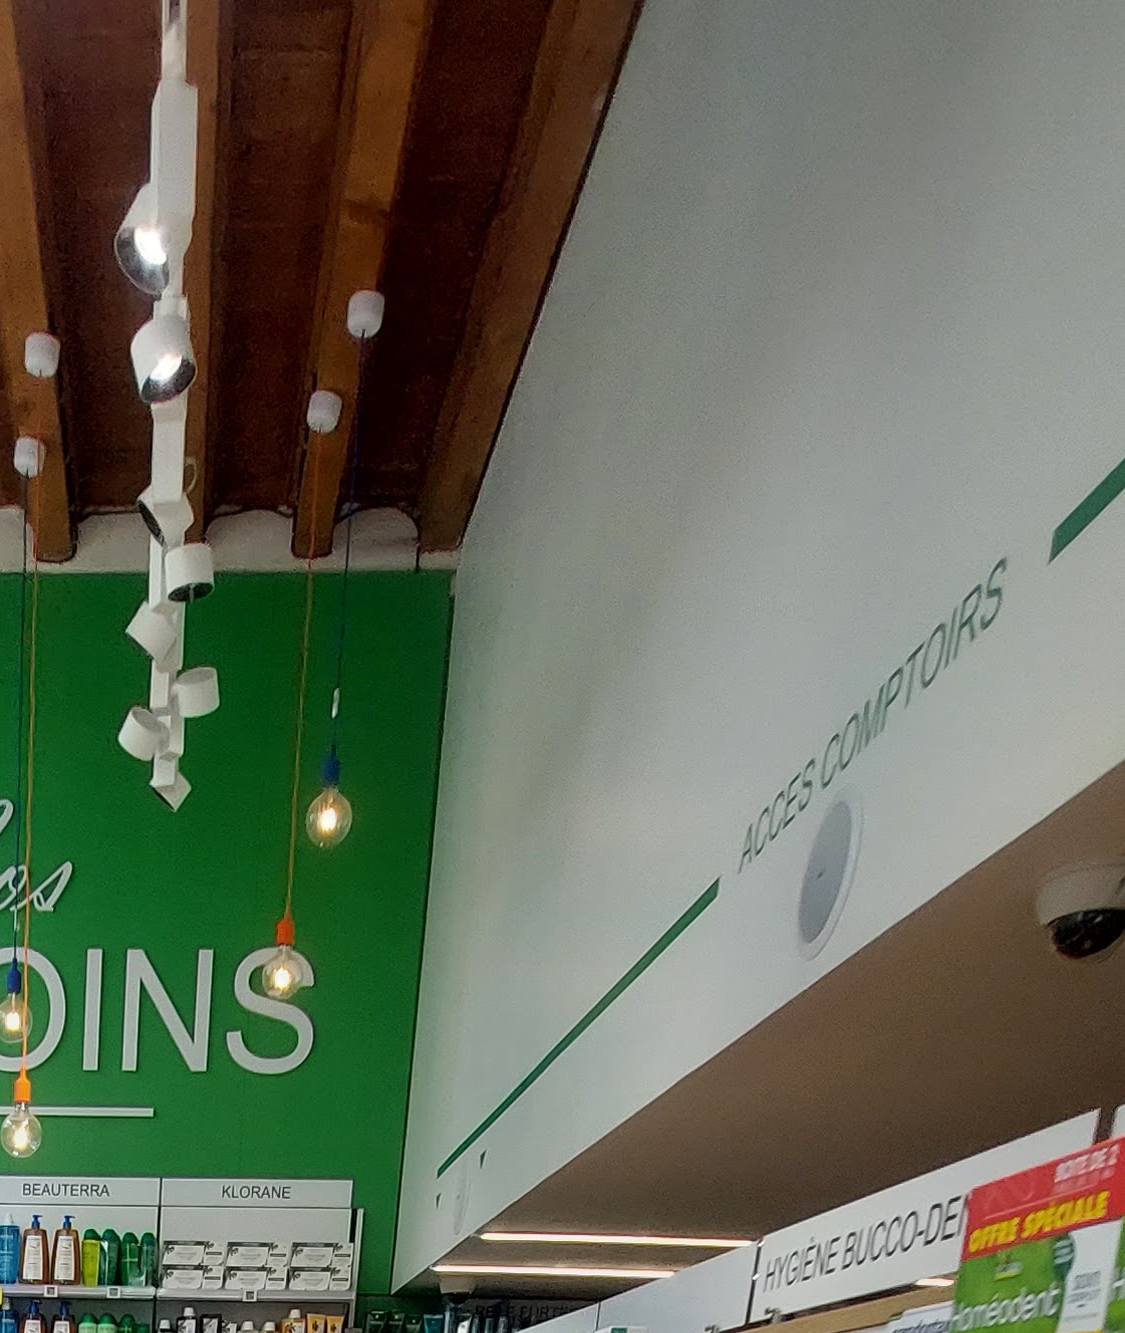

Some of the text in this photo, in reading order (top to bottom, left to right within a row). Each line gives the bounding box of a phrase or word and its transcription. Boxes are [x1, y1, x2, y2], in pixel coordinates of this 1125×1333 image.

[737, 556, 1009, 875] ACCES COMPTOIRS
[21, 1182, 111, 1198] BEAUTERRA
[220, 1184, 292, 1201] KLORANE
[762, 1235, 842, 1294] HYGIÈNE
